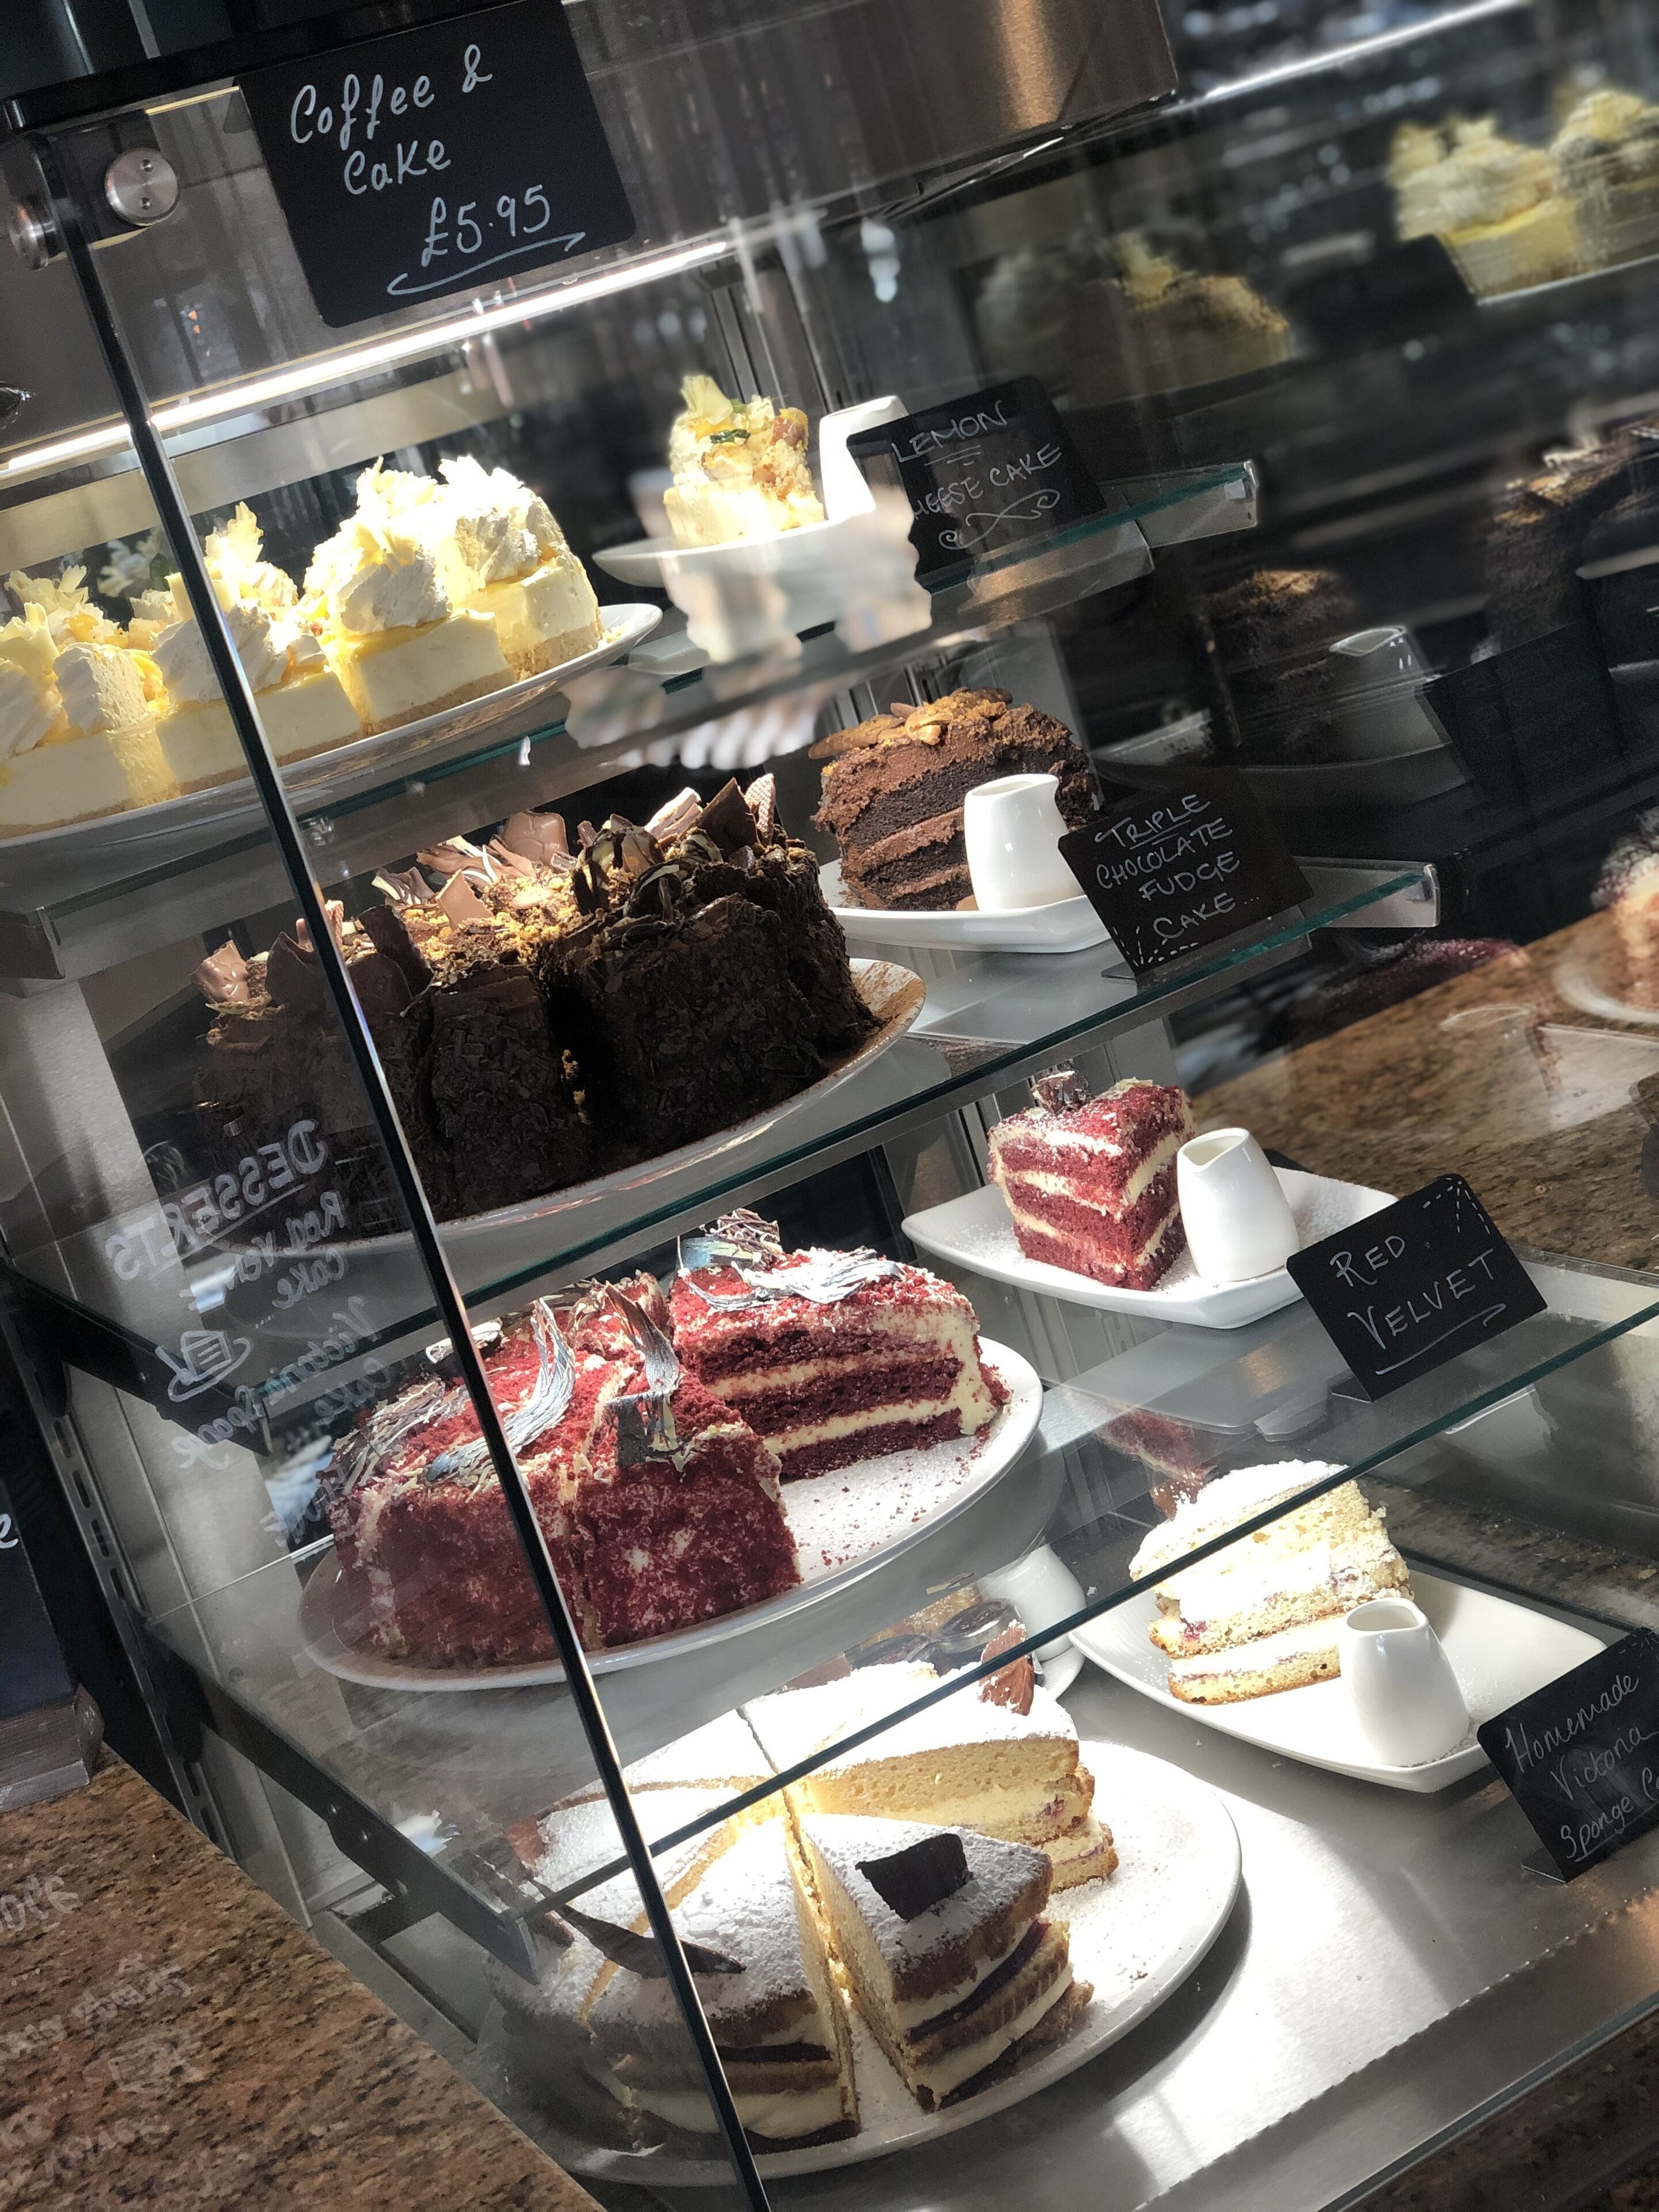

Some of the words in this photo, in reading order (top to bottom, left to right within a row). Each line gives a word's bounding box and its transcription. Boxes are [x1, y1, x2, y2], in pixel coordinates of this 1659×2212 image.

[290, 74, 434, 150] Coffee
[461, 44, 493, 93] &
[344, 139, 451, 195] Cake
[421, 184, 550, 267] £5.95
[891, 400, 1007, 463] LEMON
[914, 477, 983, 521] HEESE
[990, 443, 1062, 486] CAKE
[1094, 794, 1210, 847] TRIPLE
[1096, 817, 1233, 889] CHOCOLATE
[1138, 851, 1240, 902] FUDGE
[1330, 1235, 1406, 1287] RED
[1347, 1248, 1494, 1350] VELVET
[1505, 1675, 1639, 1772] Homemade
